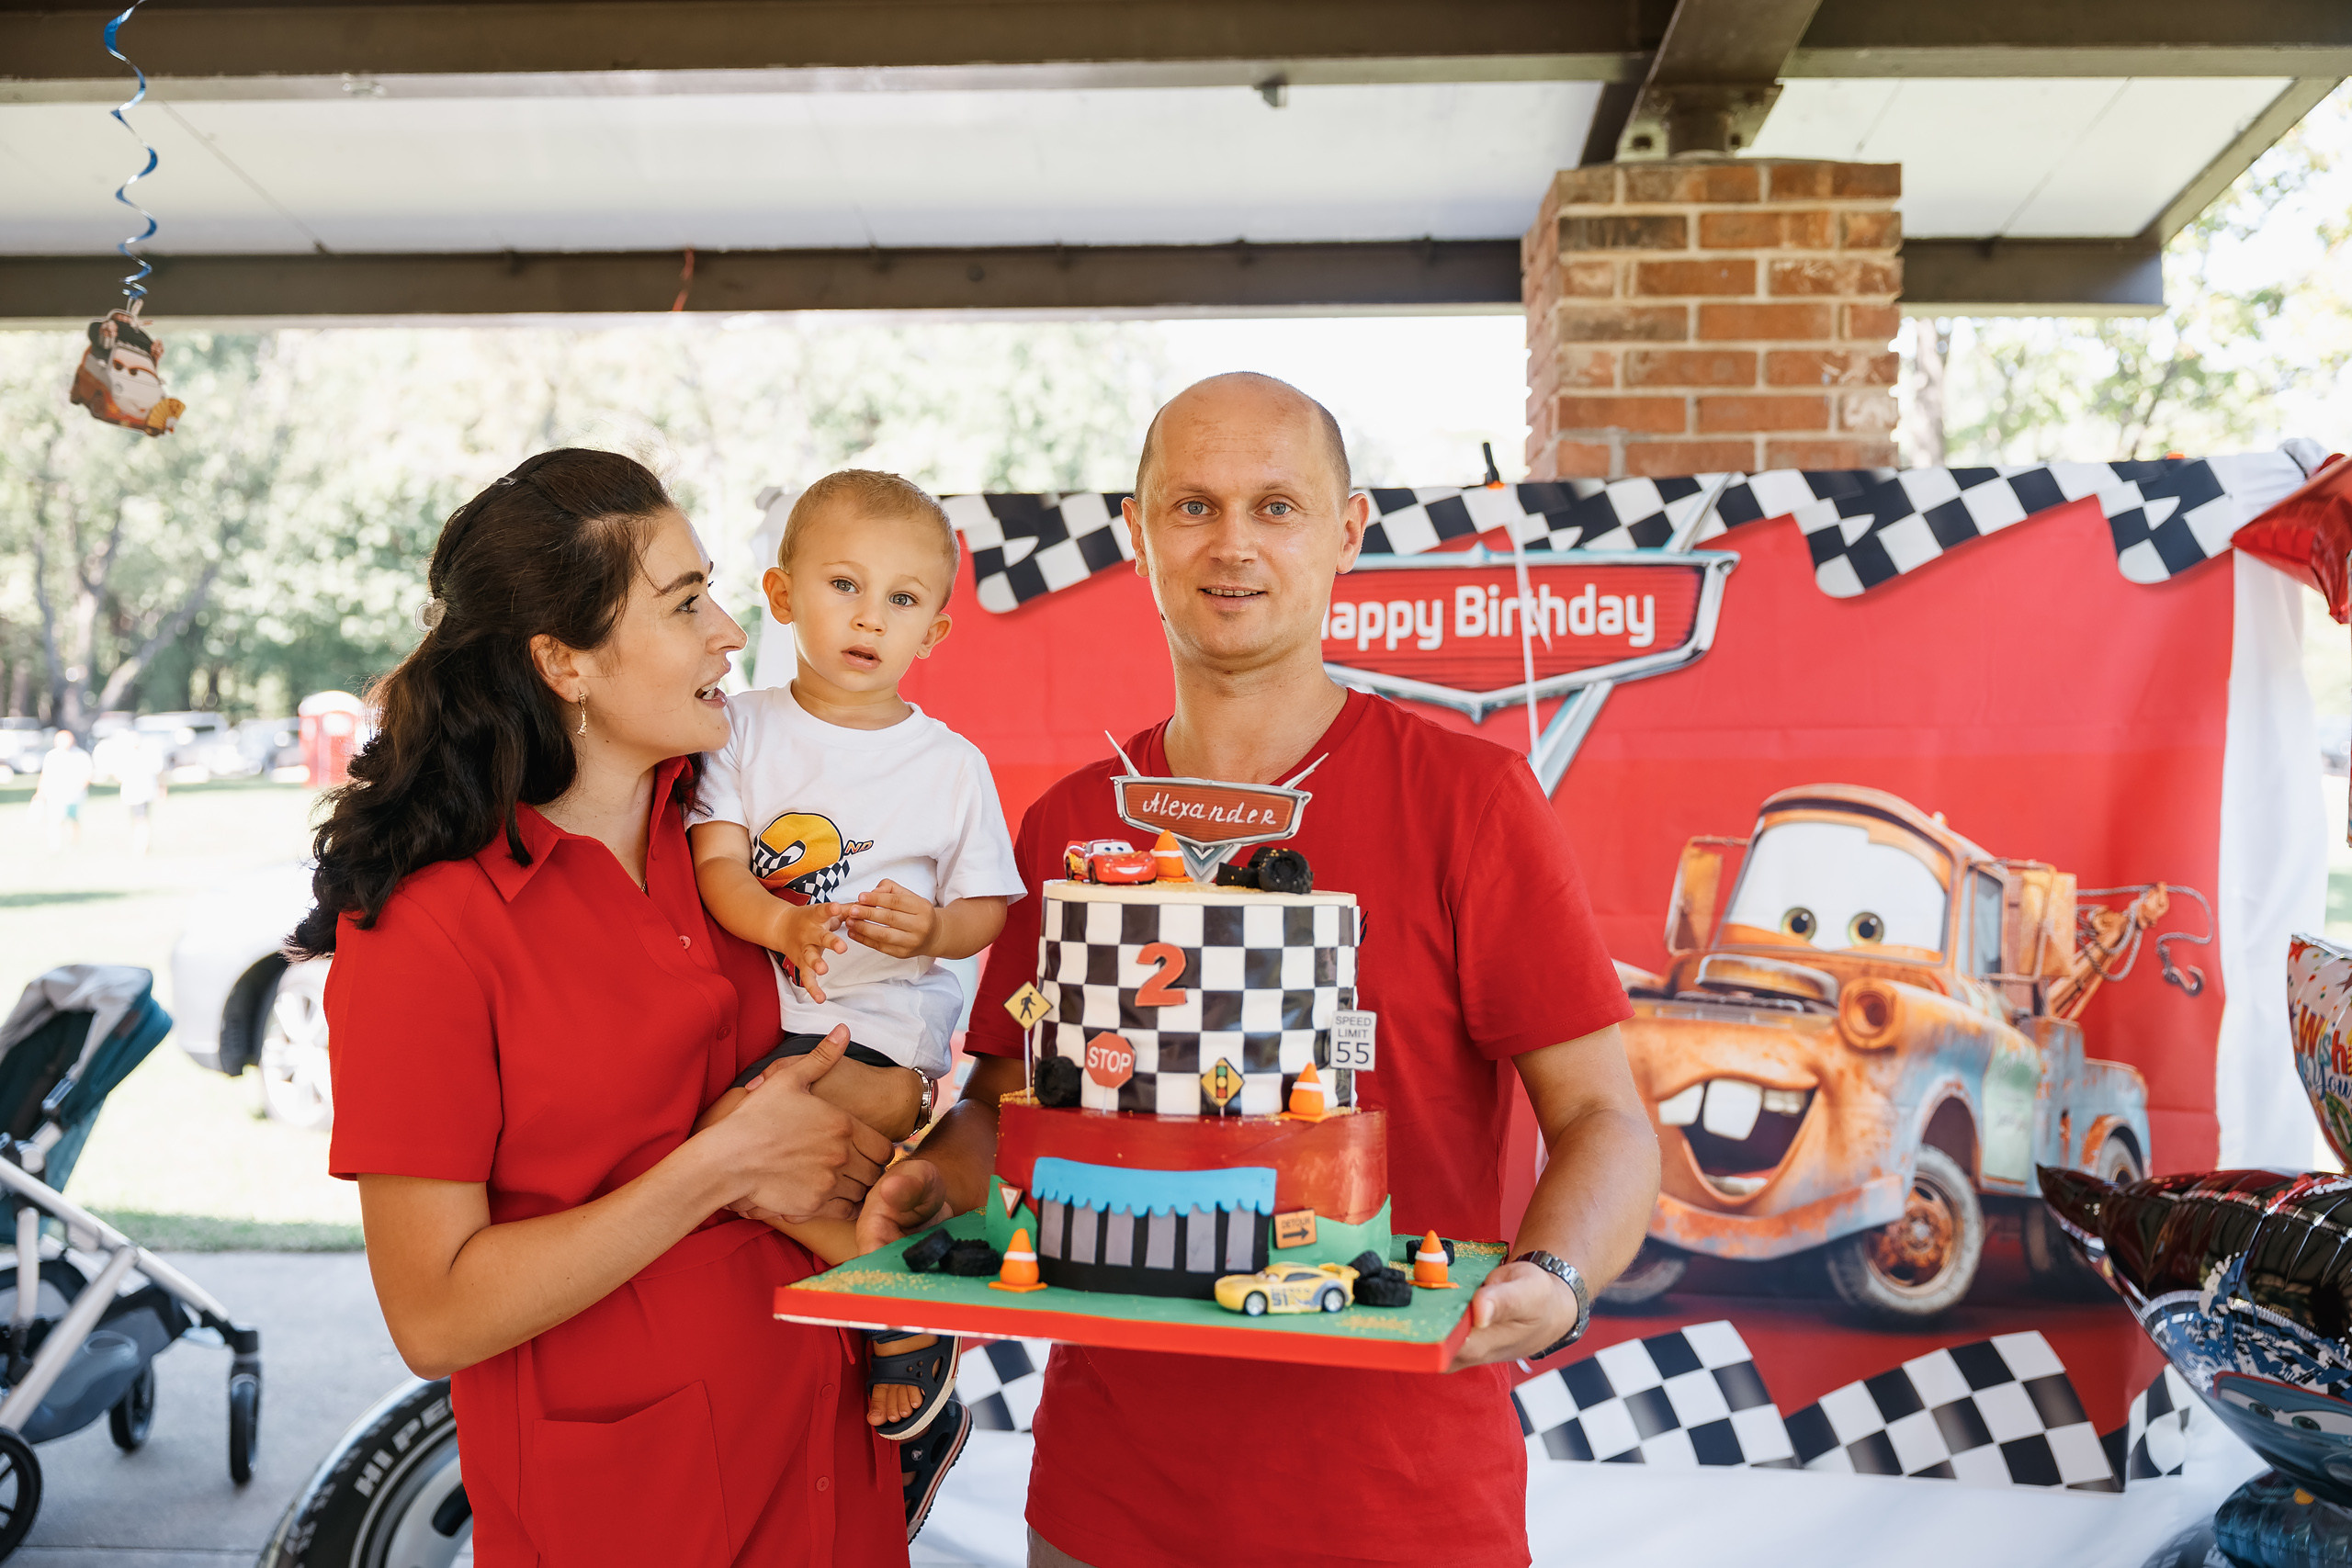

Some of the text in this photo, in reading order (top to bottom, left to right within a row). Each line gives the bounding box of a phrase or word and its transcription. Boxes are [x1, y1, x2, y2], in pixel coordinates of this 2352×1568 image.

[1321, 582, 1656, 651] appy Birthday
[1135, 942, 1188, 1008] 2
[1335, 1015, 1373, 1027] SPEED
[1338, 1028, 1369, 1038] LIMIT
[1087, 1045, 1132, 1074] STOP
[1336, 1041, 1370, 1065] 55
[1282, 1217, 1310, 1228] DETOUR
[355, 1395, 453, 1496] HI PE
